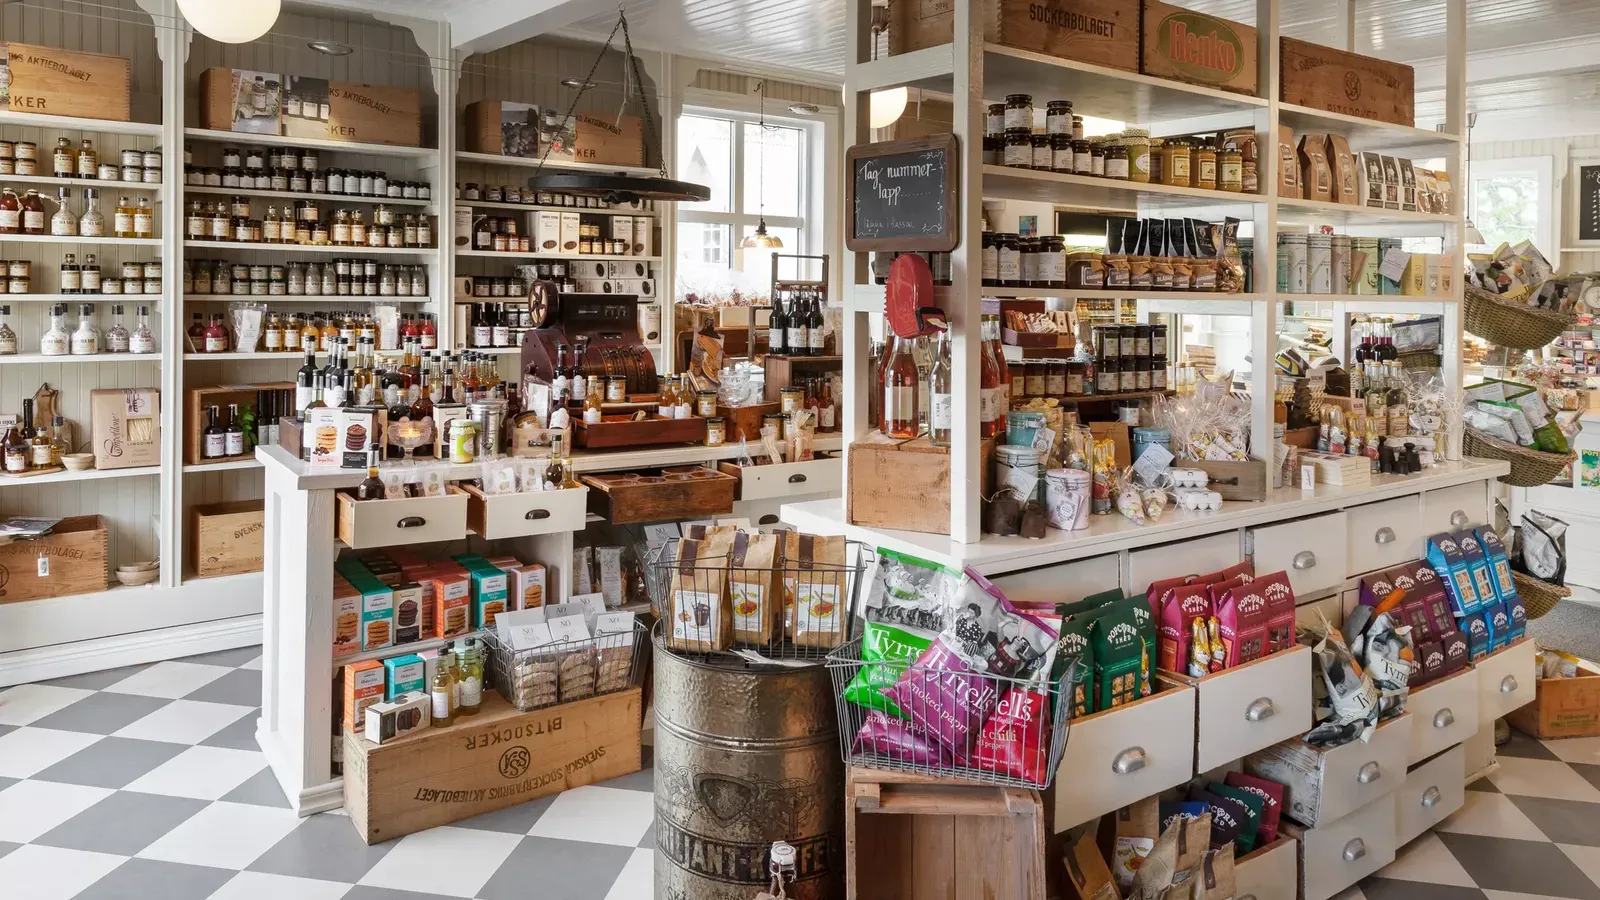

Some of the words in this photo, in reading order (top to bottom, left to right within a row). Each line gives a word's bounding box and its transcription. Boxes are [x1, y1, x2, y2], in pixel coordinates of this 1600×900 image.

[1029, 3, 1116, 38] SOCKERBOLAGET
[1169, 20, 1236, 72] Henko
[27, 56, 91, 82] AKTIEBOLAGET
[343, 90, 391, 115] AKTIEBOLAGET
[859, 160, 883, 190] Tag
[887, 163, 937, 178] nummer-
[1182, 595, 1209, 611] POPCORN
[1237, 593, 1265, 611] POPCORN
[1107, 622, 1138, 644] POPCORN
[1115, 634, 1132, 645] SHED
[465, 716, 562, 750] BITSOCKER
[564, 745, 606, 775] SVENSKA
[413, 787, 487, 803] AKTIEBOLAGET
[487, 768, 563, 800] SOCKERFABRIKS
